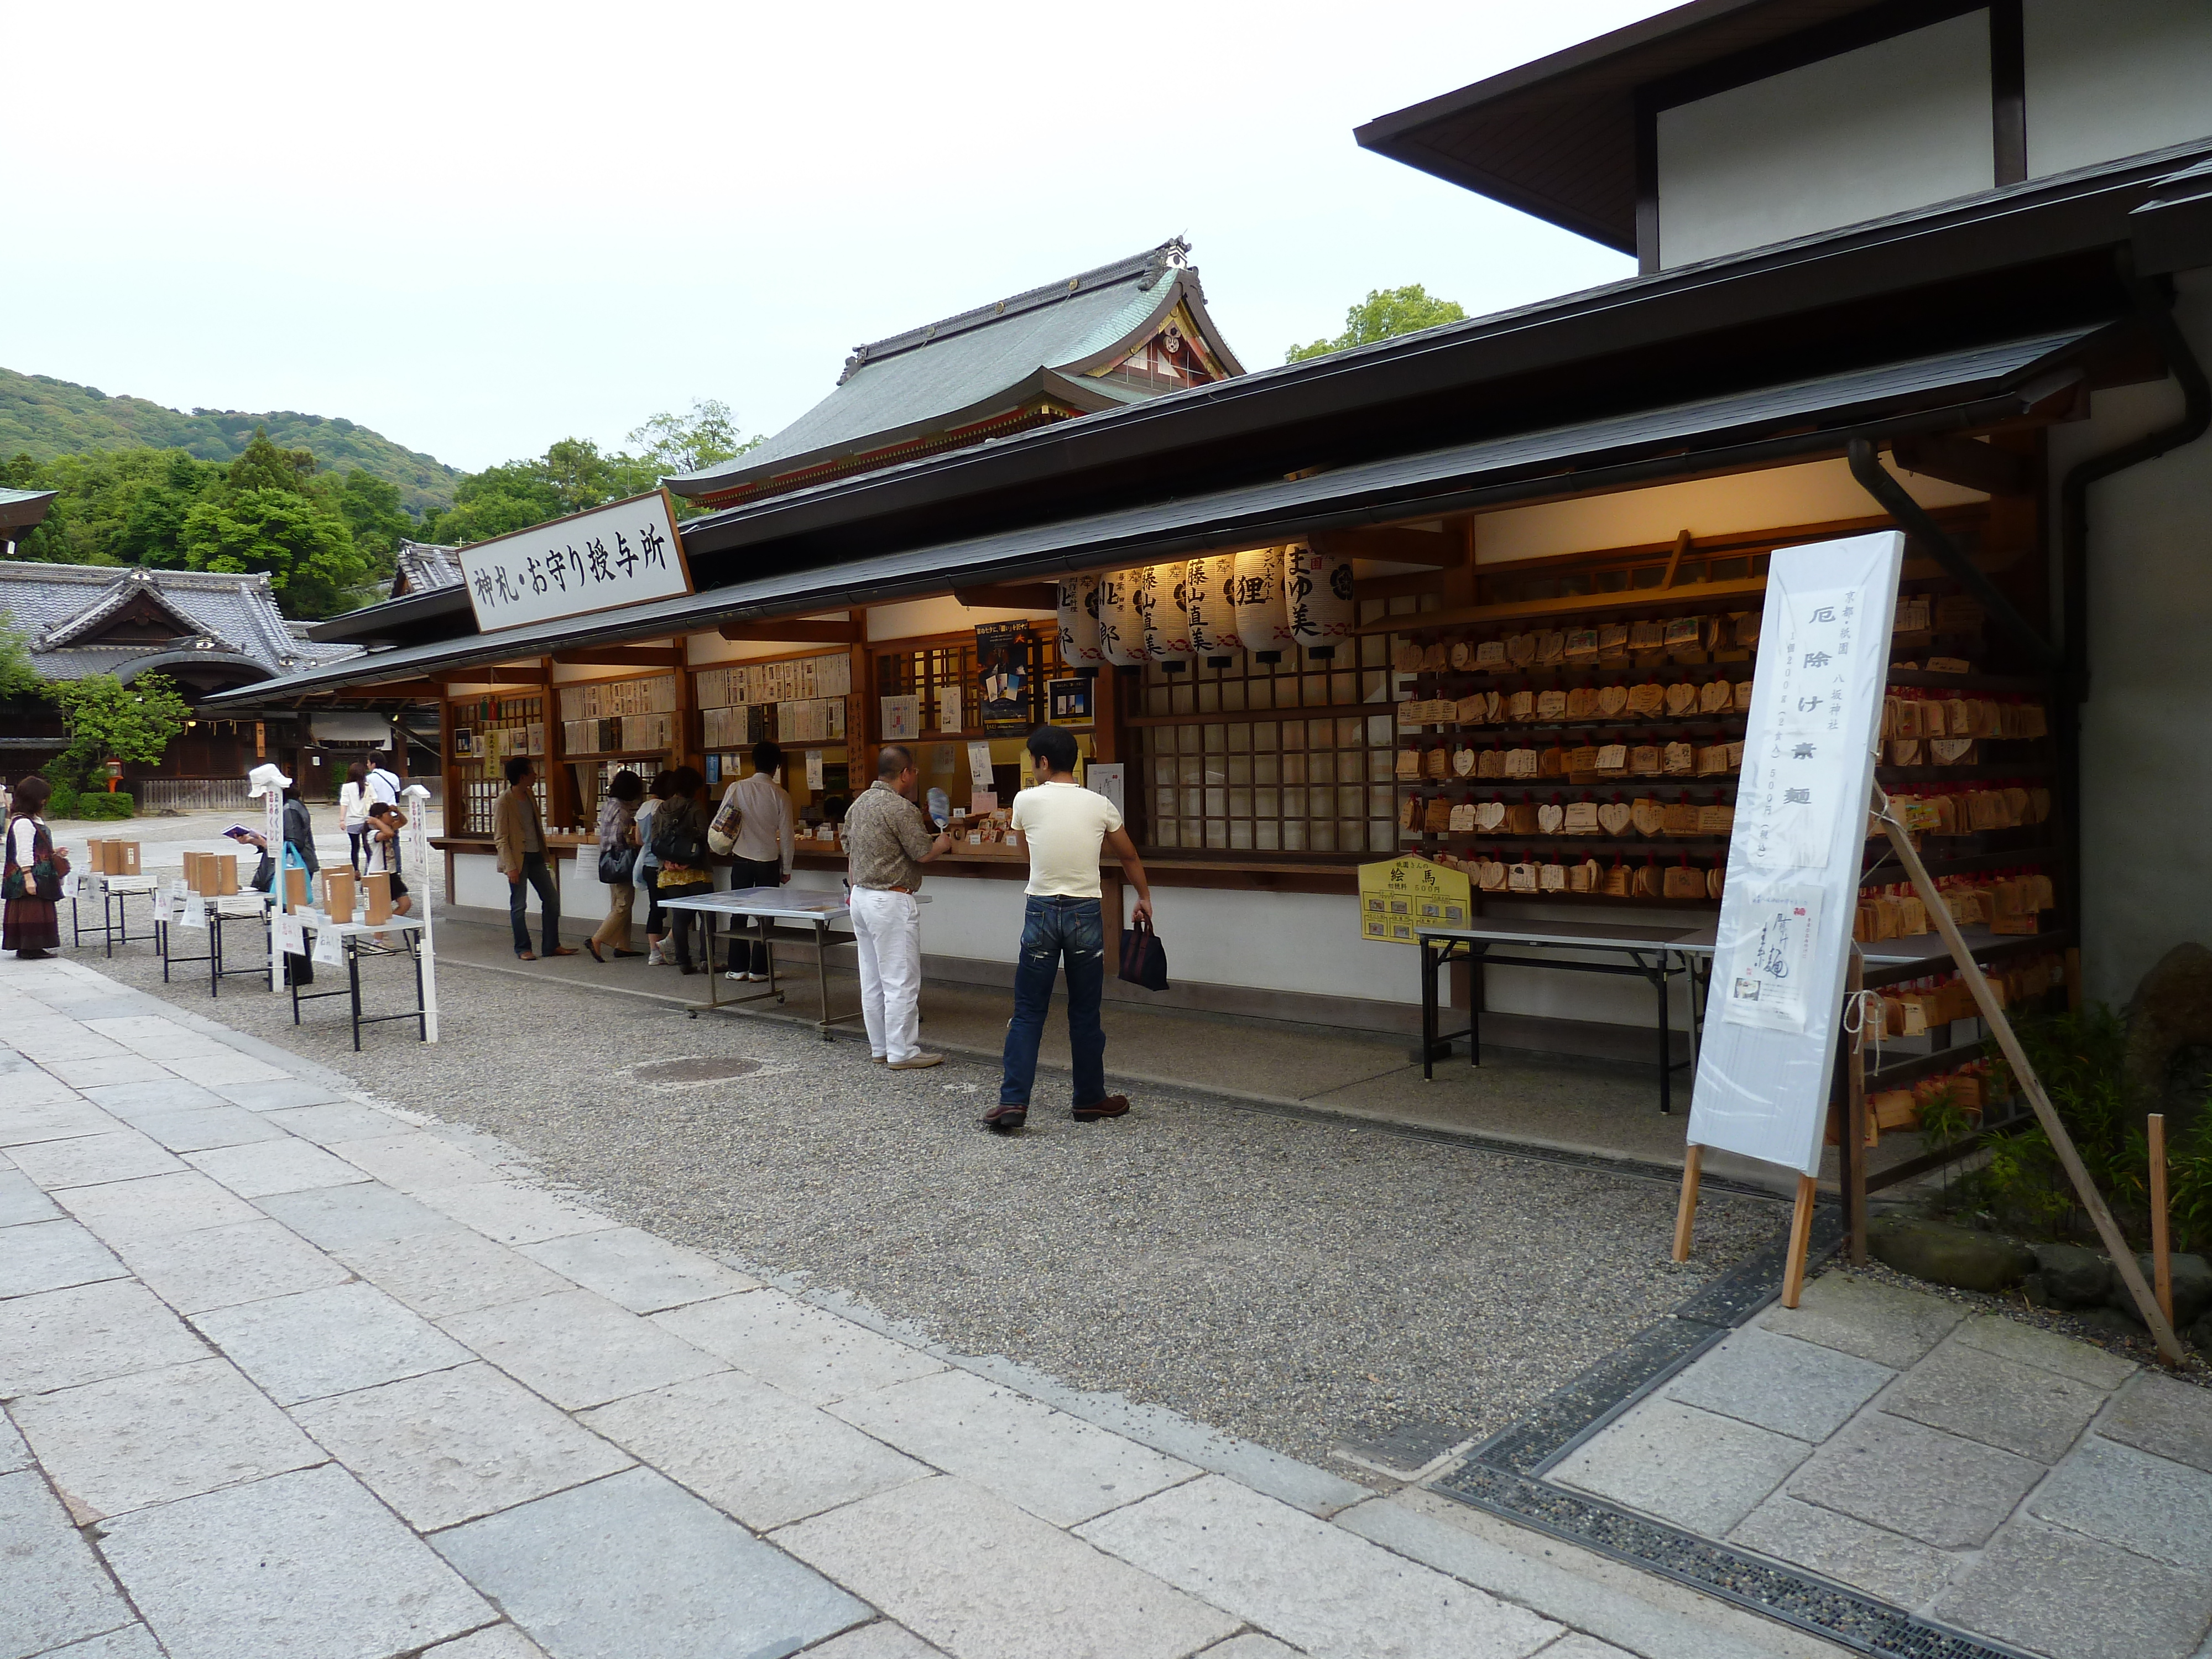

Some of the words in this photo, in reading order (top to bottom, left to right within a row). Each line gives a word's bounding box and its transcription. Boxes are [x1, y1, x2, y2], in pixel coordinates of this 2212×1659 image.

[474, 523, 666, 608] 神札・お守り授与所
[1237, 575, 1266, 607] 狸
[1264, 548, 1275, 601] メンバーズルーム
[1288, 546, 1322, 637] まゆ美
[1142, 565, 1165, 655] 藤山直美
[1188, 558, 1214, 652] 藤山直美
[1783, 606, 1837, 805] 厄除け素麺
[1827, 674, 1845, 730] 八坂神社
[1390, 868, 1436, 886] 絵馬
[1396, 861, 1429, 869] 祇園さんの
[1415, 884, 1441, 894] 500円
